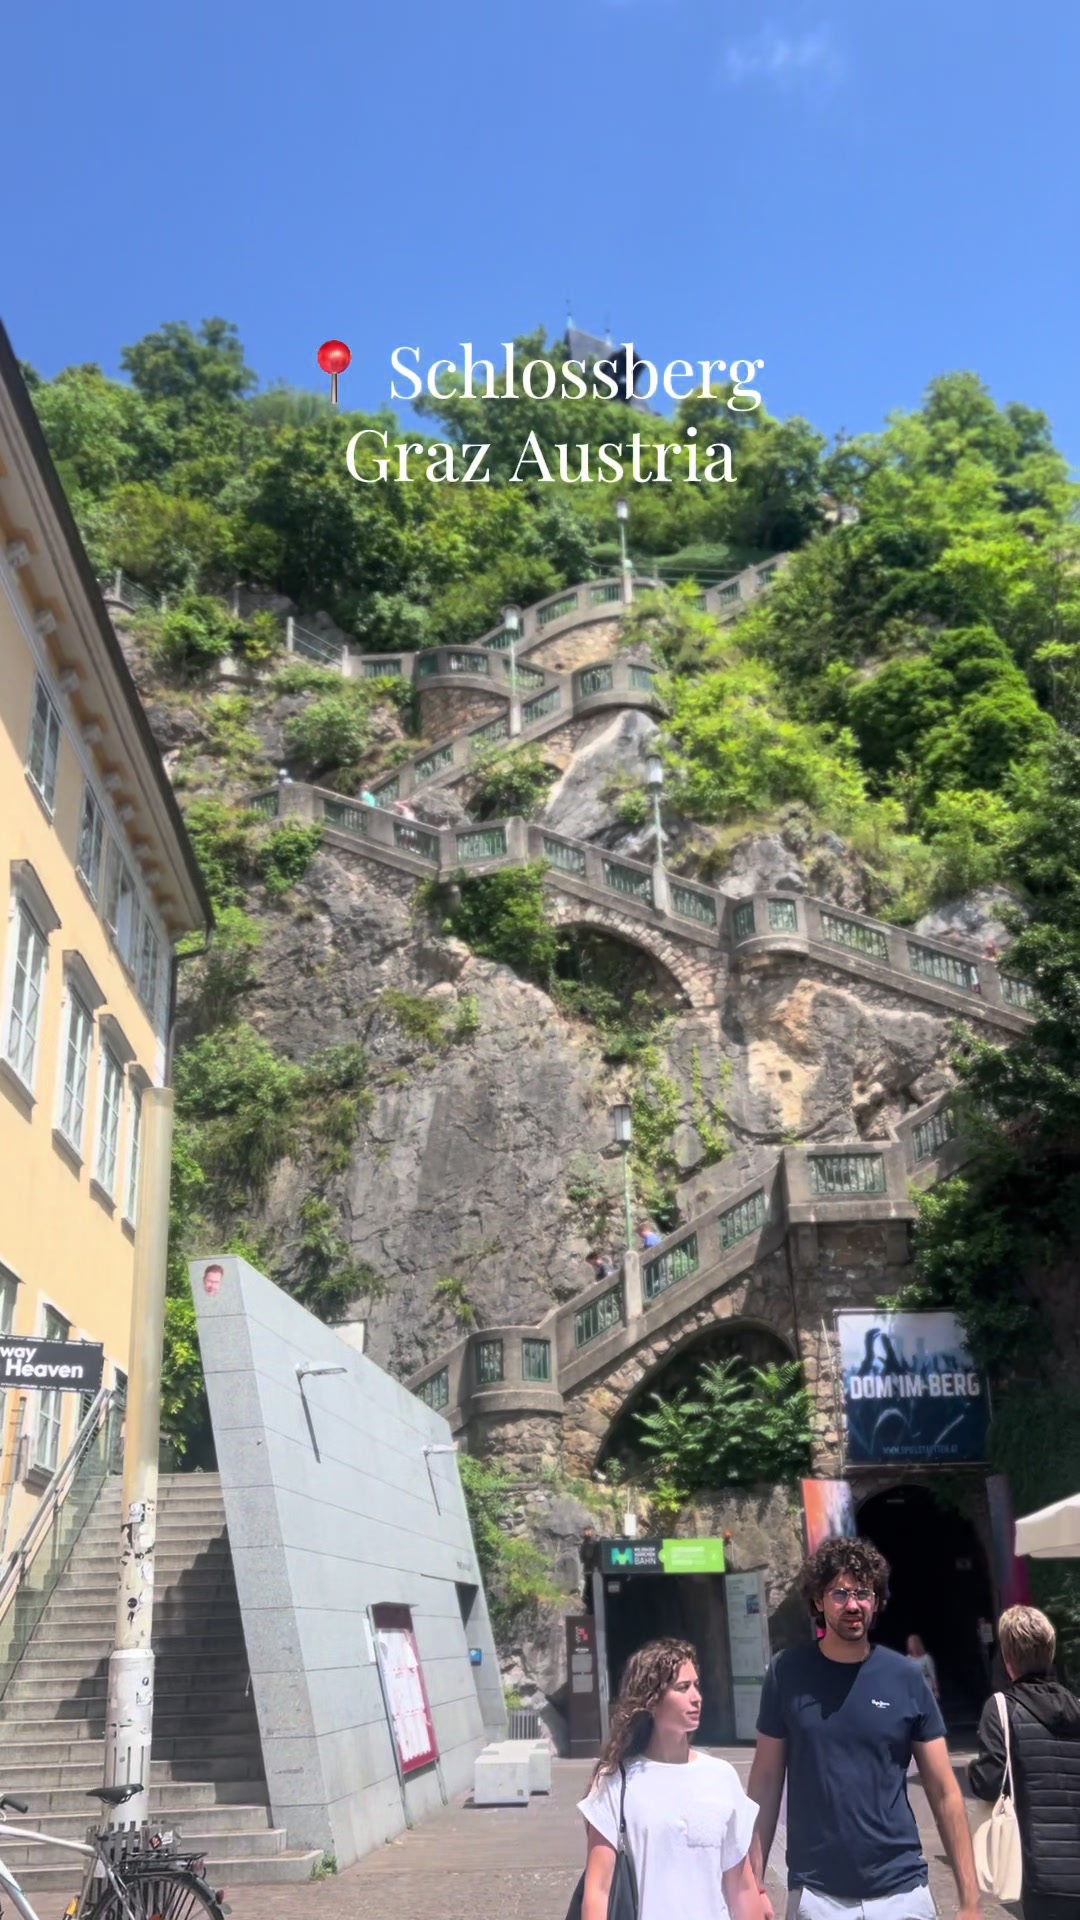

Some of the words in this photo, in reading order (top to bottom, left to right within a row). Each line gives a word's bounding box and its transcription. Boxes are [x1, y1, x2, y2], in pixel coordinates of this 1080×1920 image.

[5, 1358, 84, 1378] Heaven
[850, 1375, 893, 1399] DOM
[898, 1374, 923, 1397] IM
[928, 1373, 980, 1397] BERG
